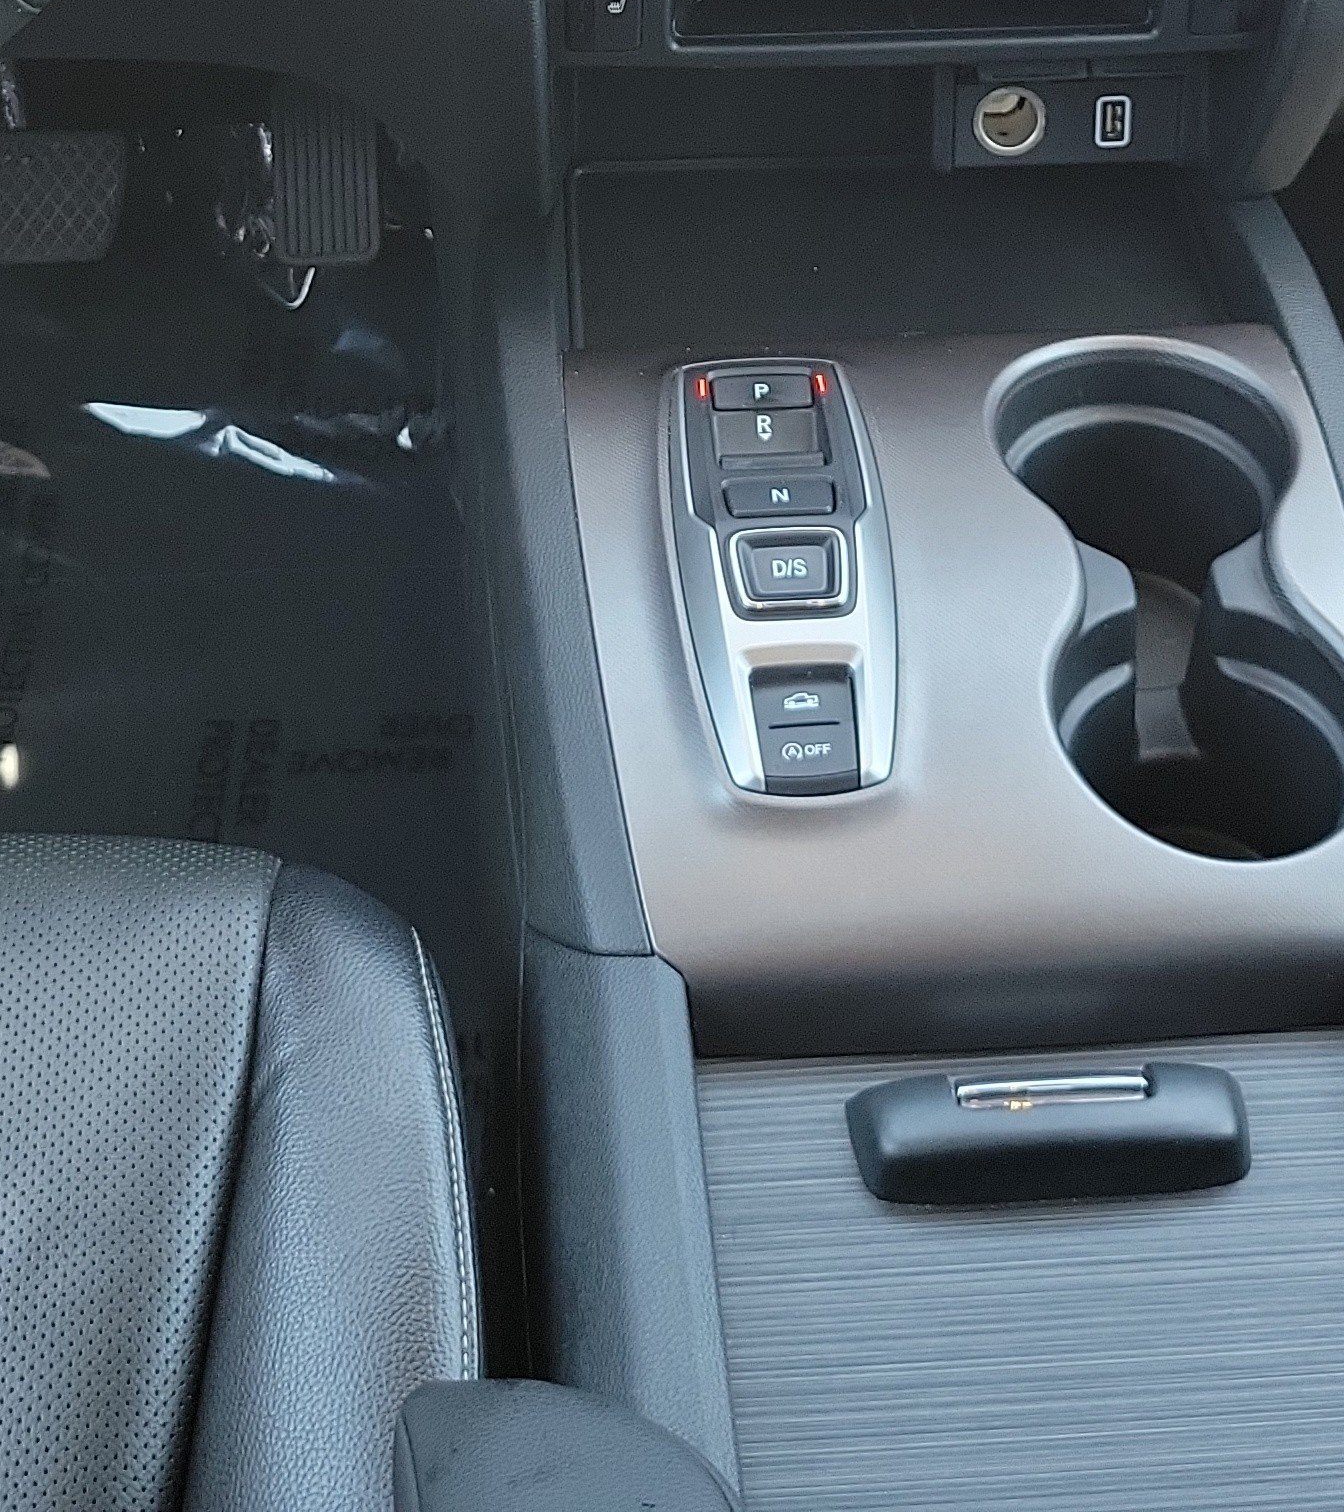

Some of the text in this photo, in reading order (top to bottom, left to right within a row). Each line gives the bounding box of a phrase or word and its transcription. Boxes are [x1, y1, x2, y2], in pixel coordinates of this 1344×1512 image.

[754, 382, 770, 400] P
[757, 414, 772, 434] R
[771, 488, 789, 503] N
[772, 558, 808, 579] D/S
[804, 742, 832, 757] OFF
